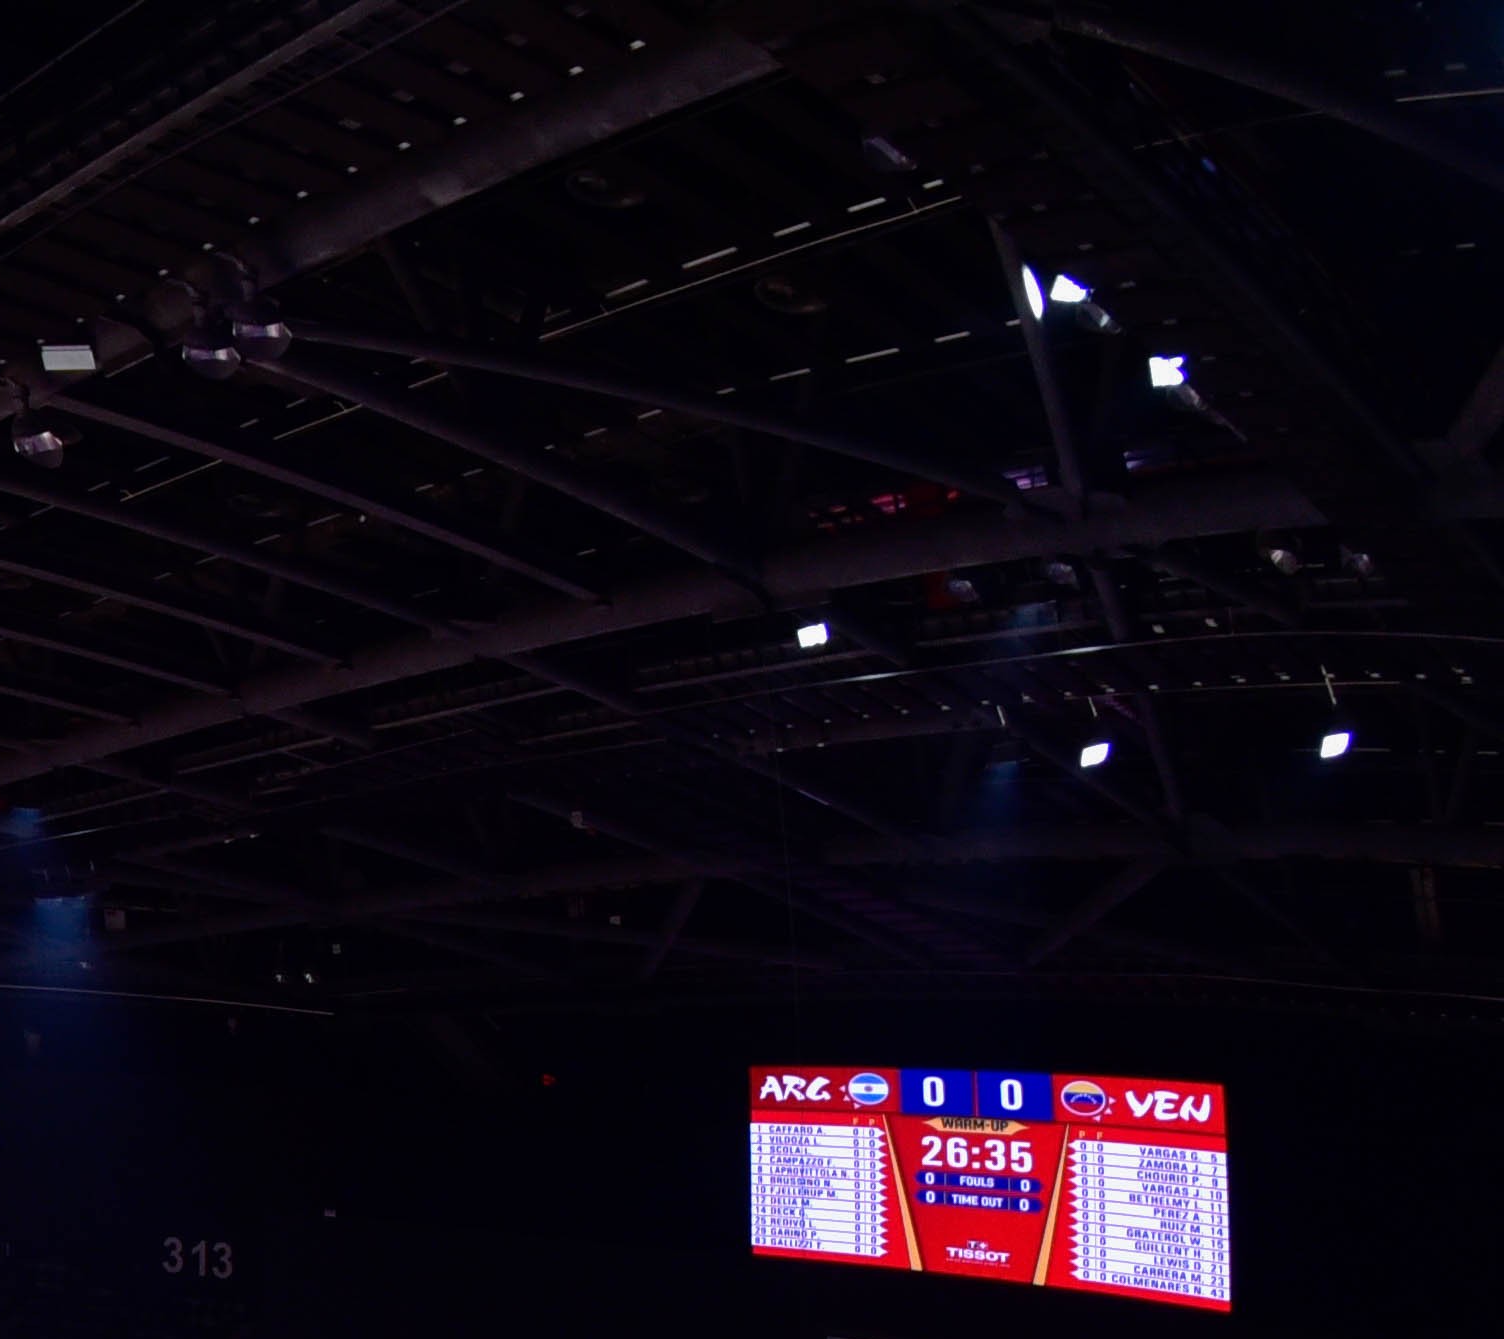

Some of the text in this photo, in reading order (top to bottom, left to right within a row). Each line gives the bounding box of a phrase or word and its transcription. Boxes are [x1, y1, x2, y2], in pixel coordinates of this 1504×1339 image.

[760, 1075, 1211, 1122] ARG 0 0 VEN
[941, 1118, 1009, 1132] WARM-UP
[921, 1136, 1033, 1172] 26:35
[959, 1176, 995, 1189] FOULS
[951, 1194, 1004, 1209] TIME OUT
[162, 1237, 232, 1279] 313
[946, 1247, 1010, 1262] TISSOT
